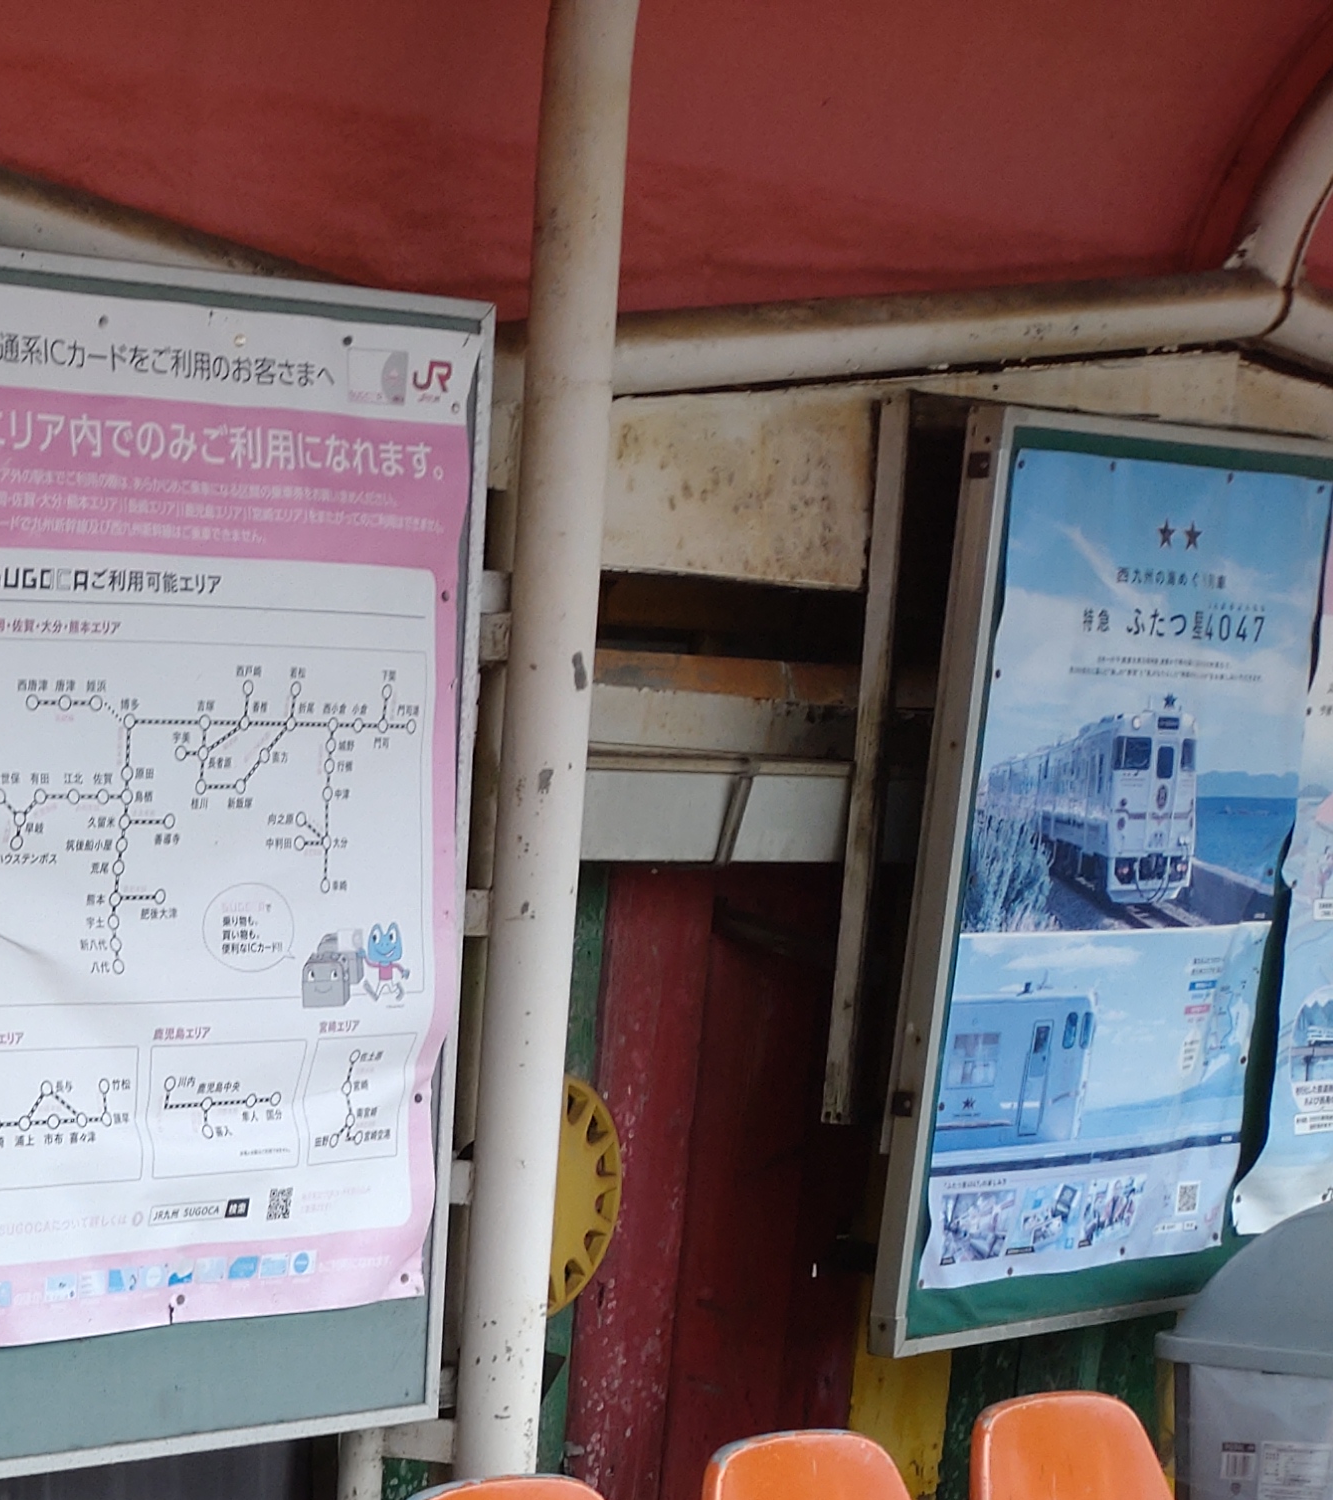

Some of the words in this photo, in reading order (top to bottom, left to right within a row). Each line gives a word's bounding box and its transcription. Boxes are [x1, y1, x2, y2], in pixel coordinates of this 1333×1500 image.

[412, 359, 453, 393] JR
[1083, 607, 1110, 633] 特急
[1126, 607, 1265, 645] ふたつ星4047
[30, 773, 50, 785] 有田
[93, 772, 113, 785] 佐賀
[87, 816, 116, 829] 久留米
[89, 862, 110, 875] 荒尾
[90, 961, 110, 974] 八代
[153, 1026, 212, 1041] 鹿児島エリア
[152, 1208, 180, 1222] JR九州
[183, 1204, 220, 1218] SUGOCA
